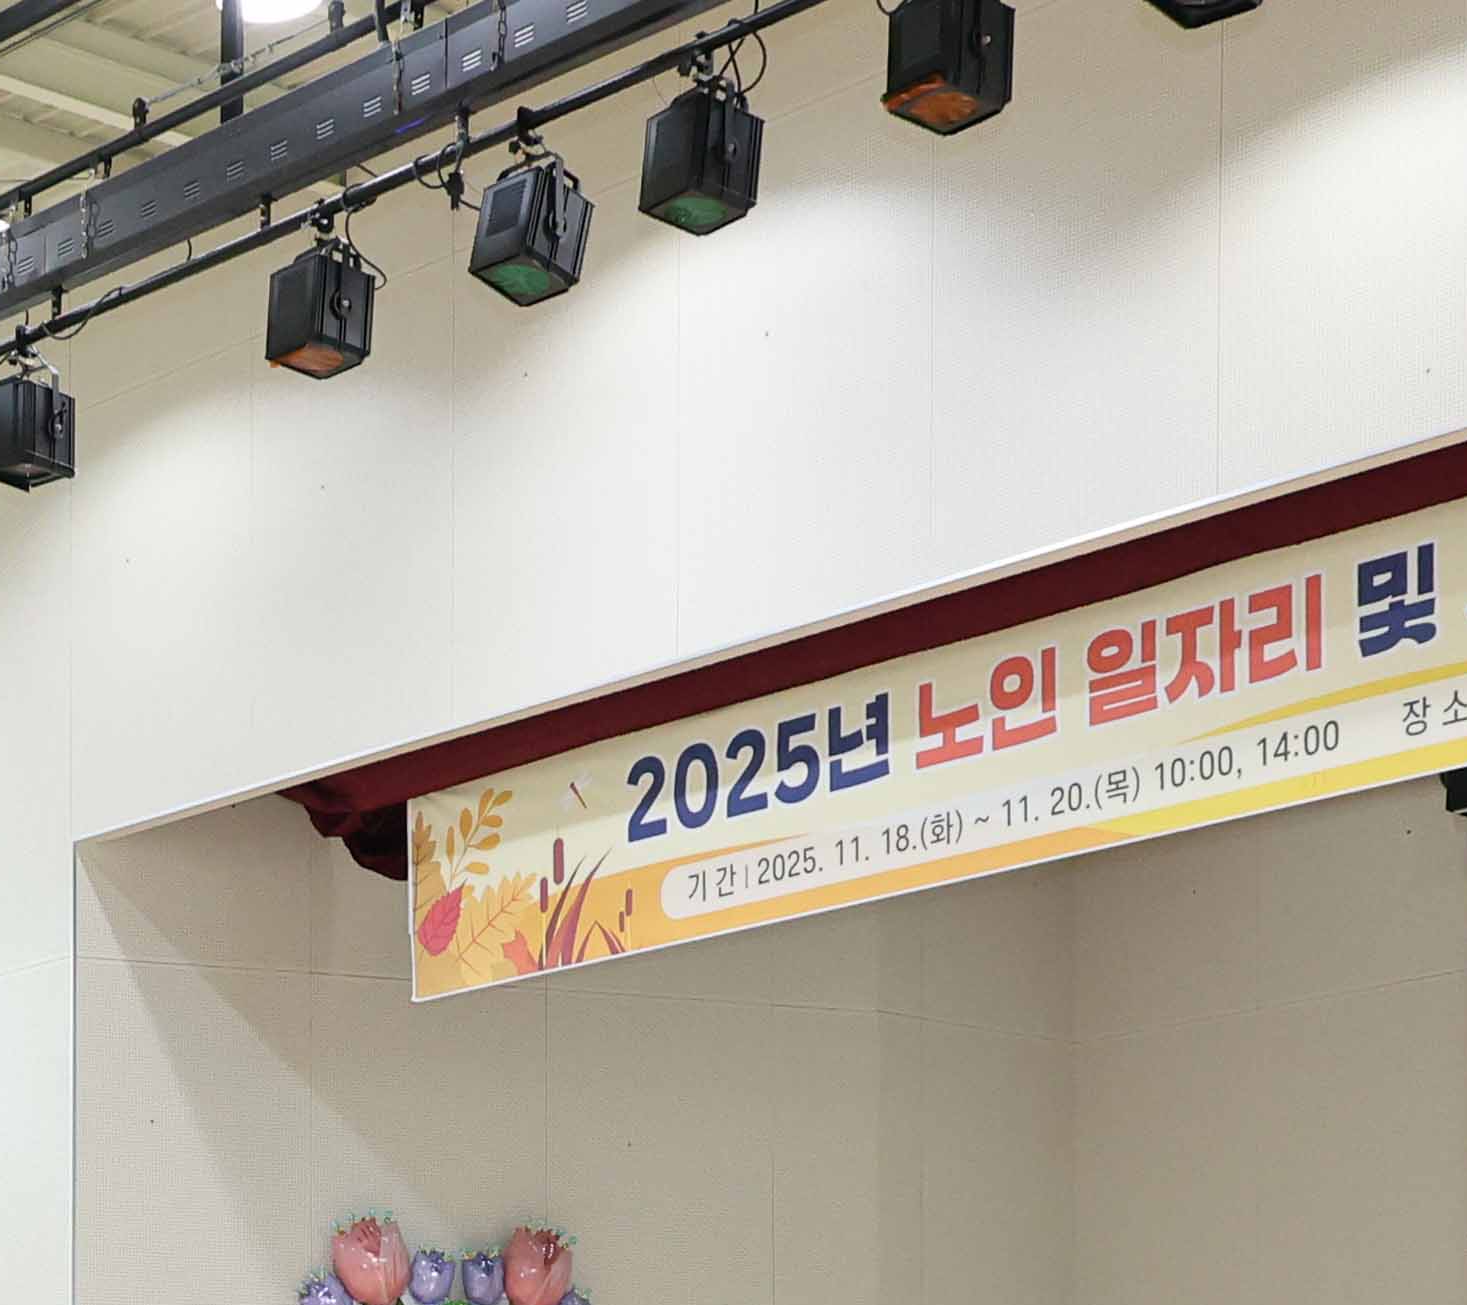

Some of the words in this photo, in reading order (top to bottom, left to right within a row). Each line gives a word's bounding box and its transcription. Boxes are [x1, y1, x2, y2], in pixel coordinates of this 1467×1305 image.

[626, 692, 892, 841] 2025년
[915, 646, 1057, 770] 노인
[1086, 572, 1322, 727] 일자리
[1356, 544, 1438, 657] 및
[757, 841, 824, 886] 2025.
[834, 834, 871, 868] 11.
[881, 809, 964, 856] 18.(화)
[1001, 797, 1040, 828] 11.
[1050, 765, 1141, 818] 20.(목)
[1154, 746, 1243, 792] 10:00,
[1256, 719, 1340, 767] 14:00
